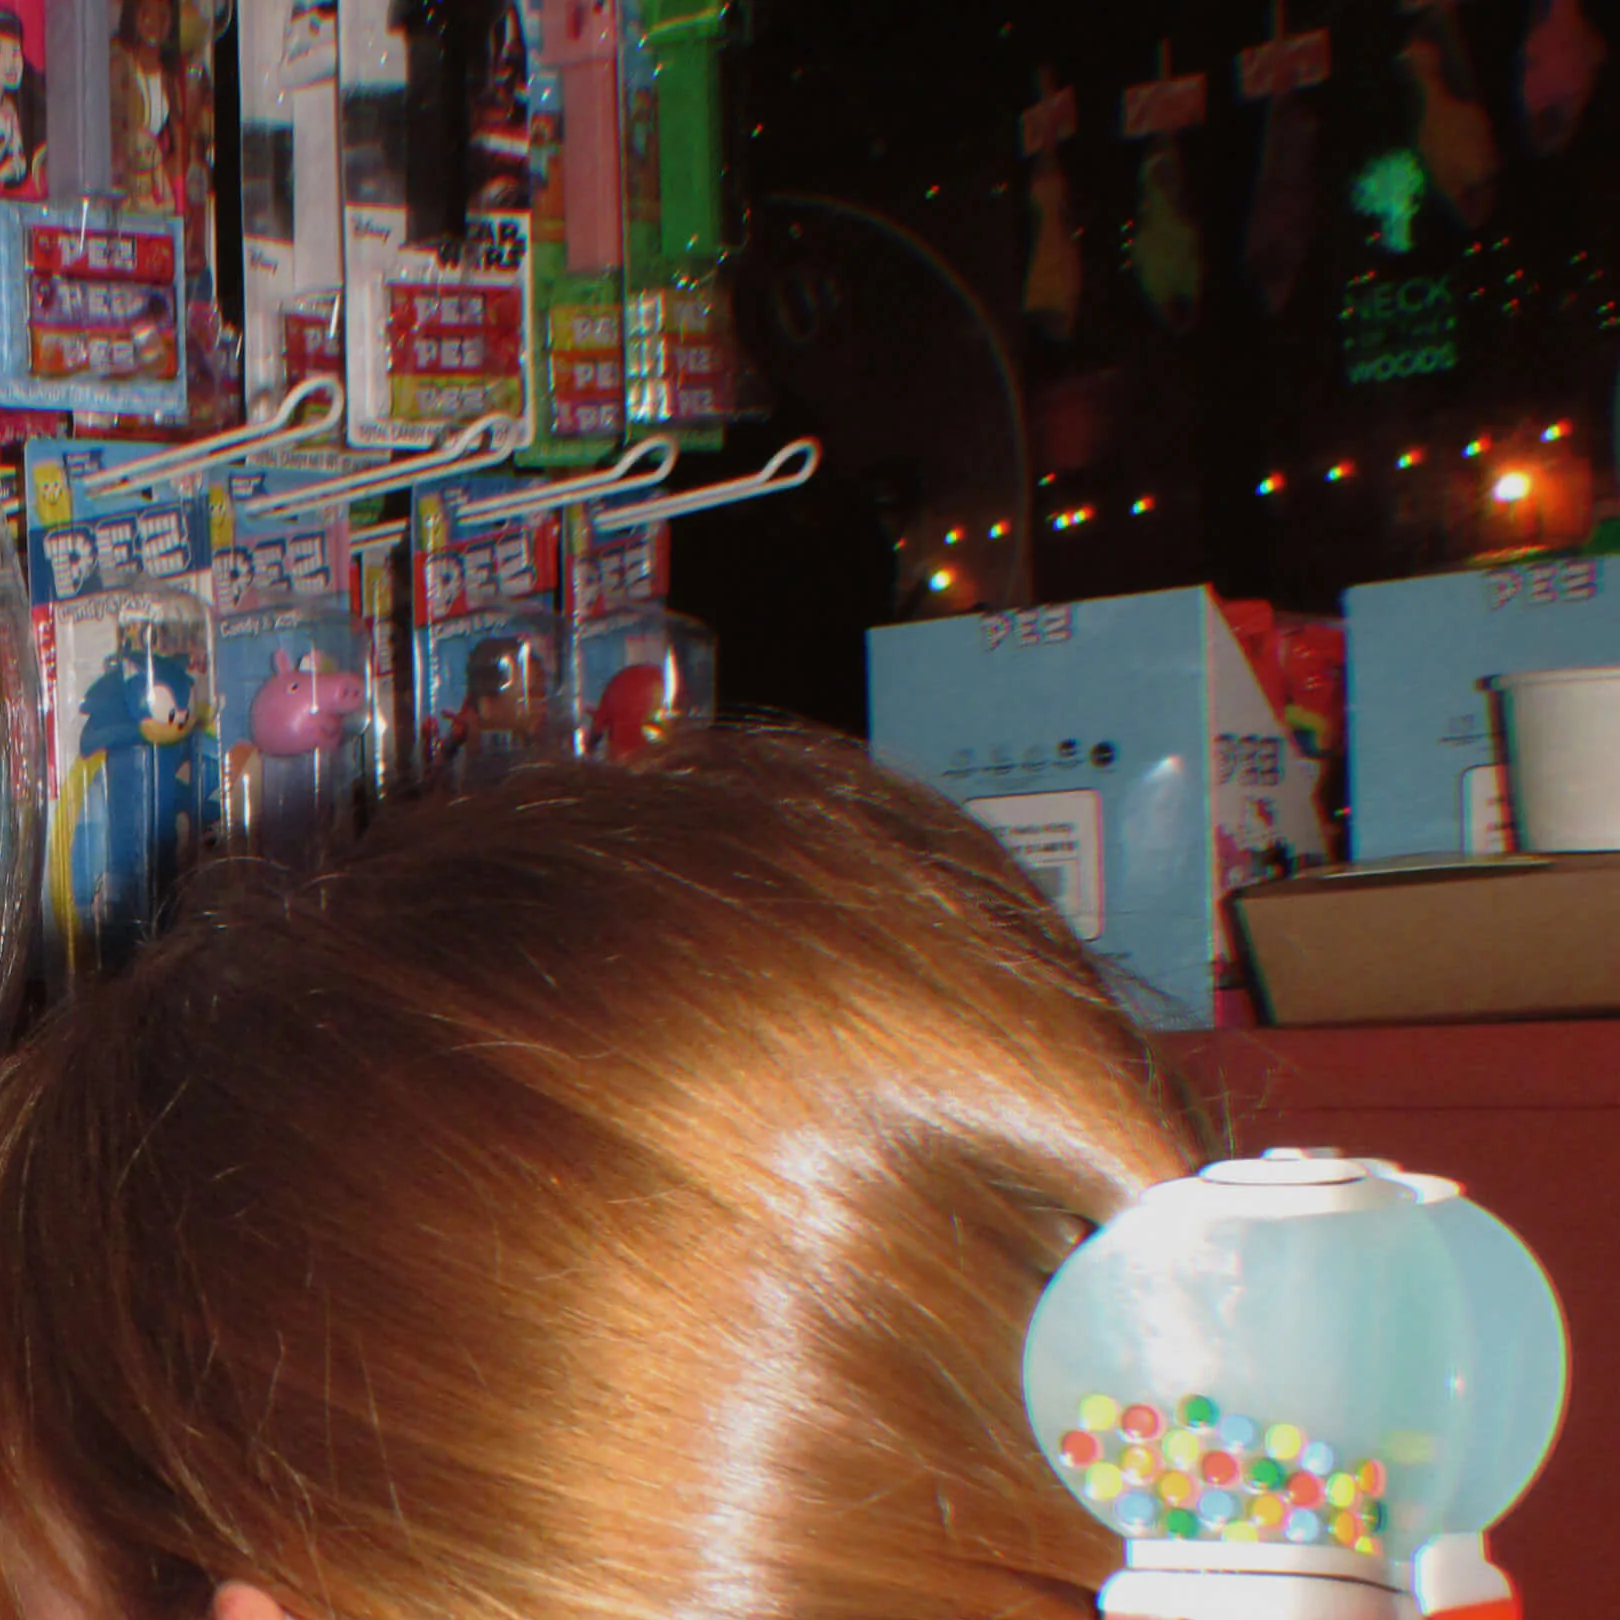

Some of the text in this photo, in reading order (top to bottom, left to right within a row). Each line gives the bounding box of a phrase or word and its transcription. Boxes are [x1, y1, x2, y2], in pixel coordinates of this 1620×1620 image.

[58, 235, 137, 272] PEZ
[414, 292, 486, 325] PEZ
[304, 327, 340, 356] PE
[572, 314, 619, 346] PE
[414, 333, 485, 370] PEZ
[574, 360, 620, 392] PE
[576, 402, 620, 431] PE
[43, 500, 192, 599] PEZ
[211, 530, 330, 614] PEZ
[425, 529, 538, 619] PEZ
[573, 536, 655, 619] PEZ
[1482, 559, 1599, 612] PEZ
[220, 615, 260, 639] Candy
[980, 603, 1074, 653] PEZ
[1214, 733, 1284, 787] PEZ
